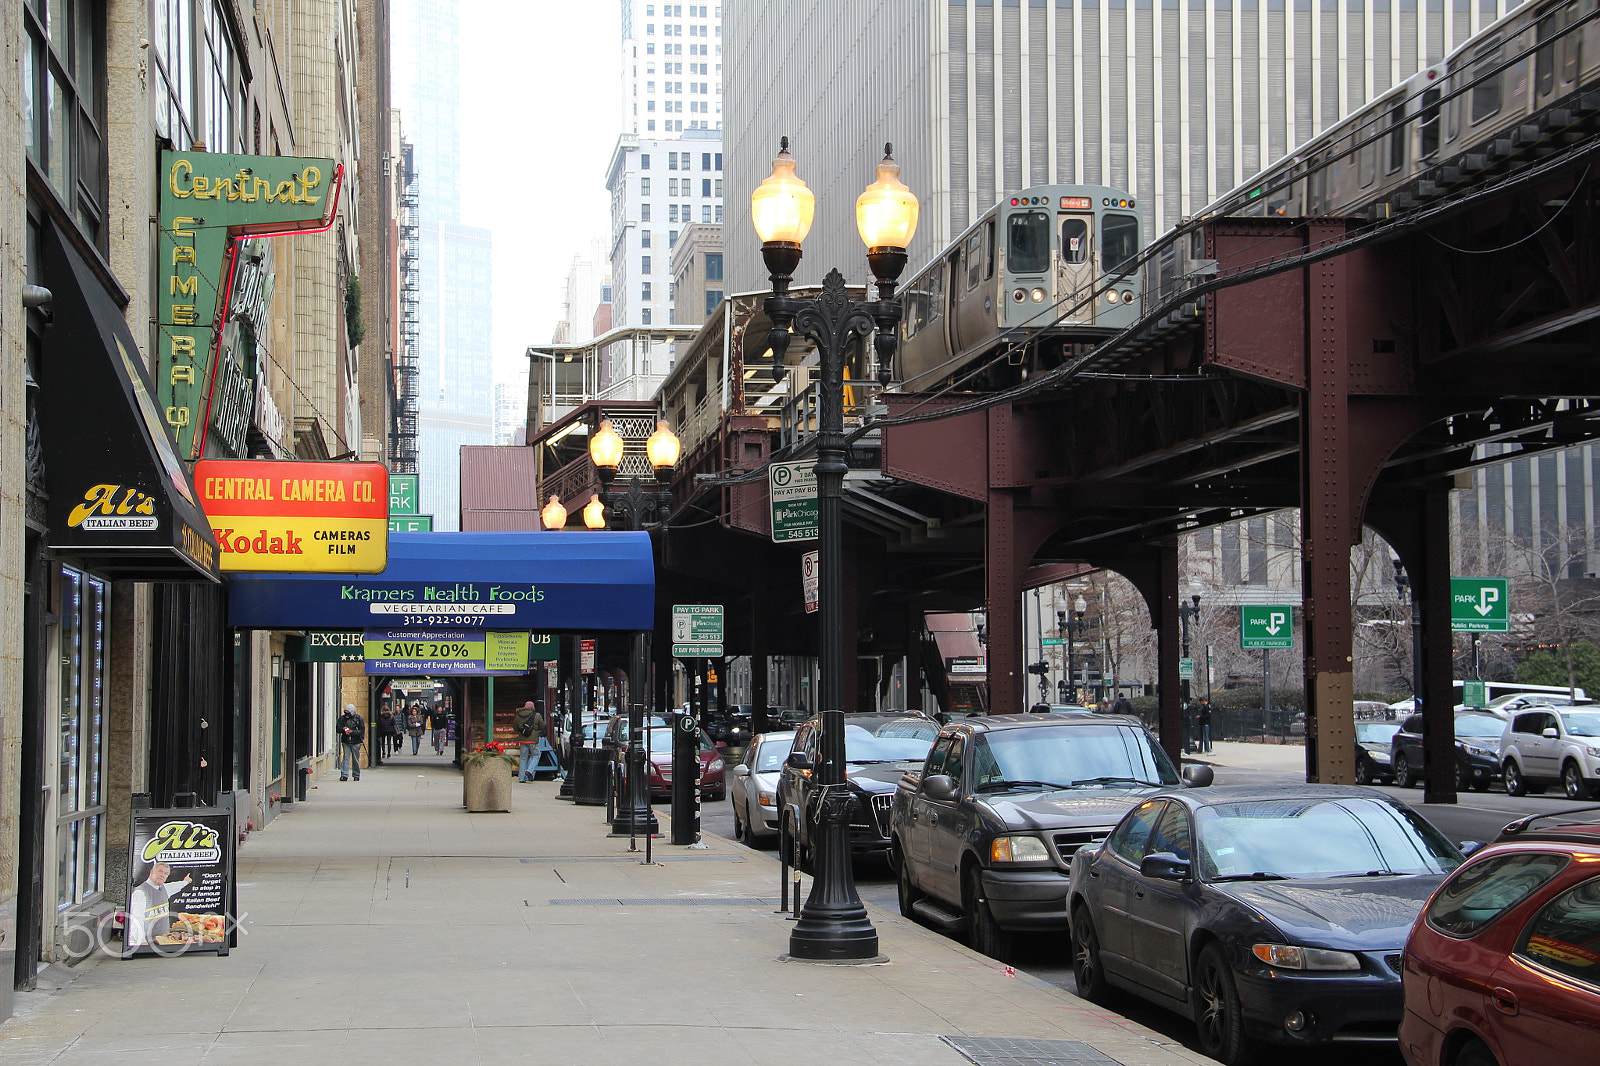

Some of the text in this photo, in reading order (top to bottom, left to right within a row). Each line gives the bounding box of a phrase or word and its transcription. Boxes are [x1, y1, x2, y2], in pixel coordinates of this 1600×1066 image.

[170, 160, 321, 204] Central
[166, 217, 198, 440] CAMERAS
[205, 477, 376, 503] CENTRAL CAMERA CO.
[68, 484, 155, 528] Al's
[782, 509, 818, 519] ParkChicag
[87, 519, 154, 528] ITALIAN BEEF
[313, 531, 371, 541] CAMERAS
[788, 530, 803, 539] 545
[804, 528, 818, 537] 513
[213, 528, 303, 555] Kodak
[328, 545, 356, 555] FILM
[341, 584, 545, 603] Kramers Health Foods
[1454, 595, 1476, 603] PARK
[384, 604, 503, 613] VEGETARIAN CAFE
[403, 616, 485, 626] 312-922-0077
[310, 633, 364, 646] EXCHE
[387, 631, 465, 640] Customer Appreciation
[531, 634, 551, 644] UB
[383, 643, 469, 658] SAVE 20%
[375, 661, 476, 670] First Tuesday of Every Month
[144, 824, 216, 860] Al's
[160, 851, 192, 859] ITALIAN
